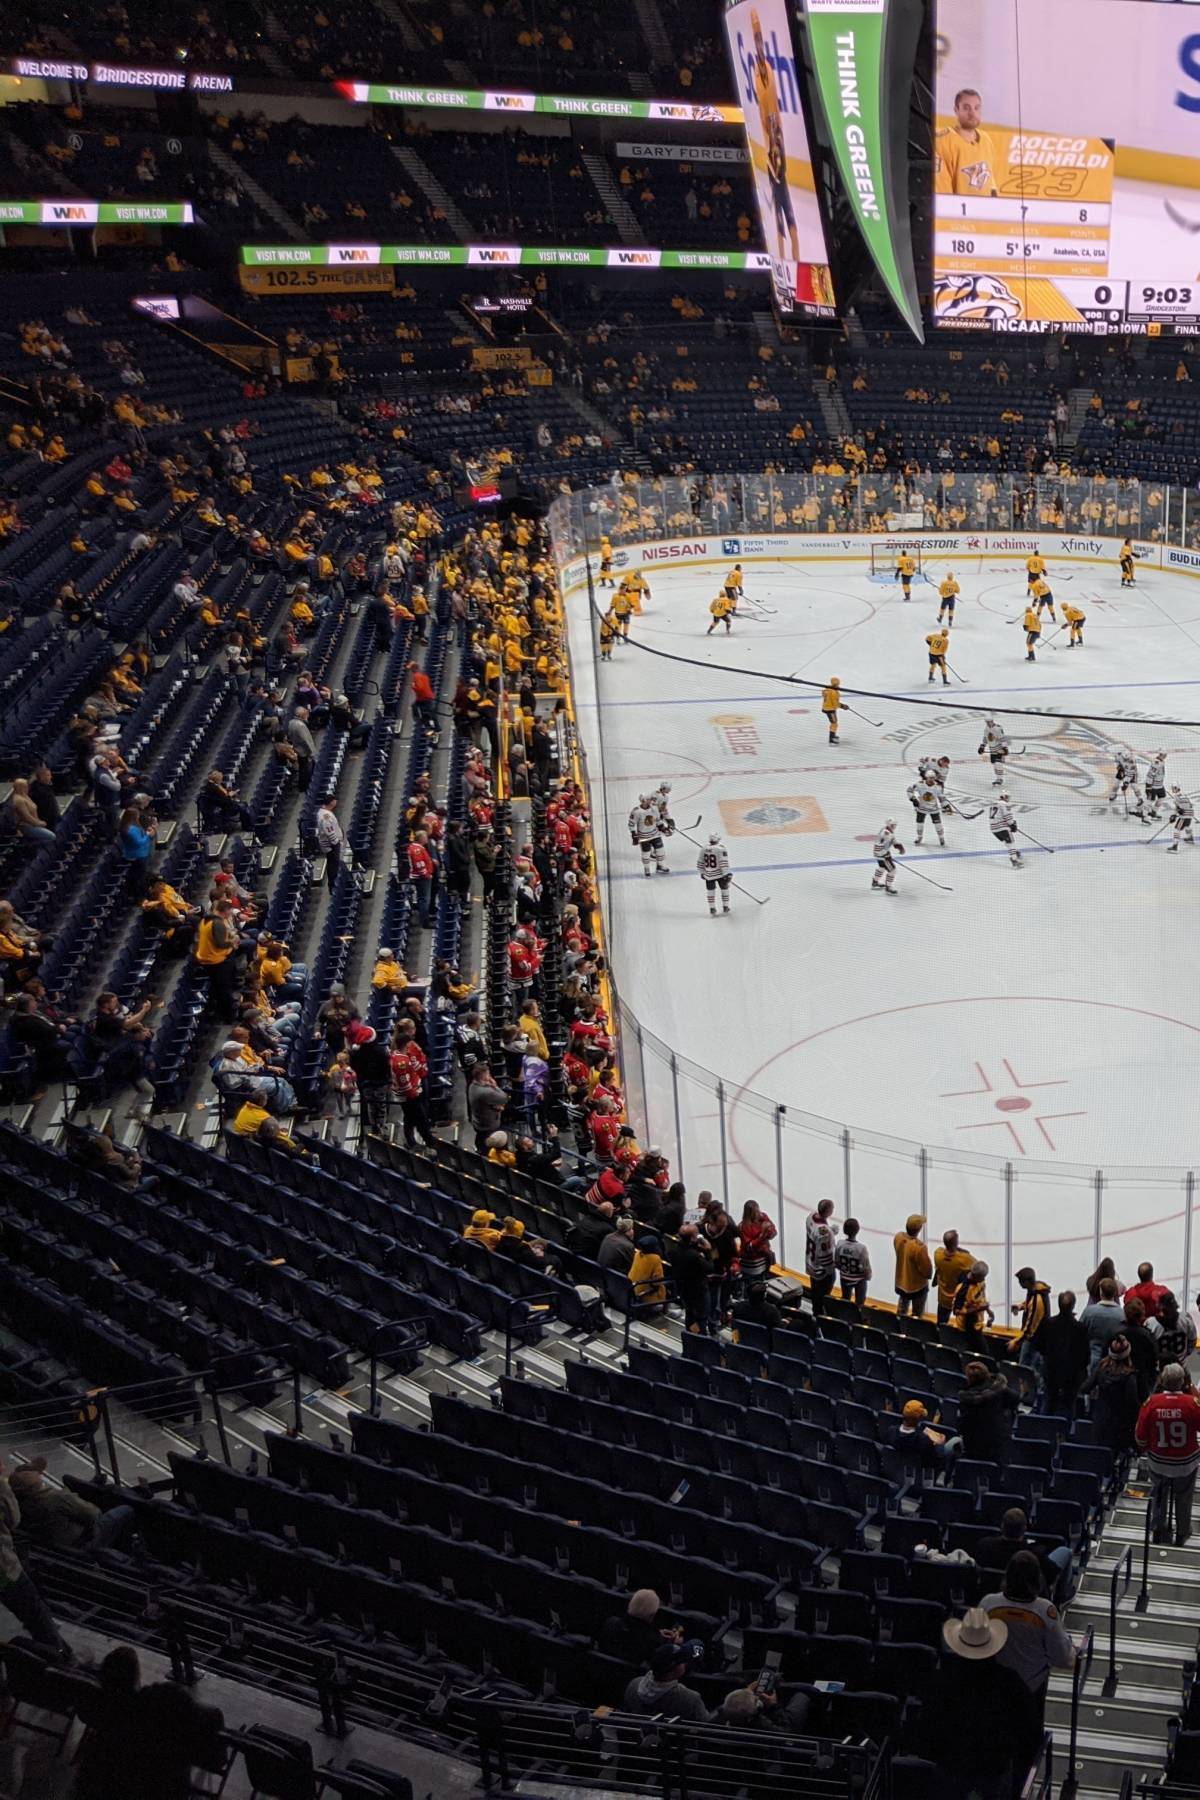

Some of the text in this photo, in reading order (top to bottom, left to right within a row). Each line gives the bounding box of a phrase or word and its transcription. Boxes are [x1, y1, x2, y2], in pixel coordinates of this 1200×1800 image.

[18, 60, 233, 91] WELCOME TO BRIDGESTONE ARENA
[836, 31, 861, 118] THINK
[387, 89, 424, 103] THINK
[495, 96, 525, 109] WM
[554, 99, 588, 114] THINK
[659, 106, 688, 118] WM
[1009, 135, 1089, 153] ROCCO
[632, 146, 733, 160] GARY FORCE
[1008, 150, 1110, 169] GRIMALDI
[999, 166, 1089, 198] 23
[53, 206, 87, 219] WM
[116, 207, 168, 219] VISIT WM.COM
[961, 203, 967, 216] 1
[1020, 206, 1029, 220] 7
[1079, 209, 1088, 223] 8
[952, 240, 975, 253] 180
[1093, 249, 1106, 257] USA
[339, 250, 369, 261] WM
[478, 250, 510, 261] WM
[619, 252, 650, 264] WM
[267, 271, 319, 286] 102.5
[342, 270, 393, 285] GAME
[1094, 286, 1112, 305] 0
[1142, 287, 1192, 304] 9:03
[997, 319, 1050, 333] NCAAF
[1062, 323, 1095, 334] MINN
[1108, 325, 1119, 334] 23
[1120, 324, 1147, 335] IOWA
[1175, 325, 1200, 335] FINAL
[985, 537, 1040, 550] Lochinvar
[1061, 538, 1103, 555] xfinity
[642, 543, 707, 561] NISSAN
[1170, 552, 1190, 565] BUD
[1156, 1408, 1182, 1419] TOEWS
[1155, 1421, 1188, 1448] 19
